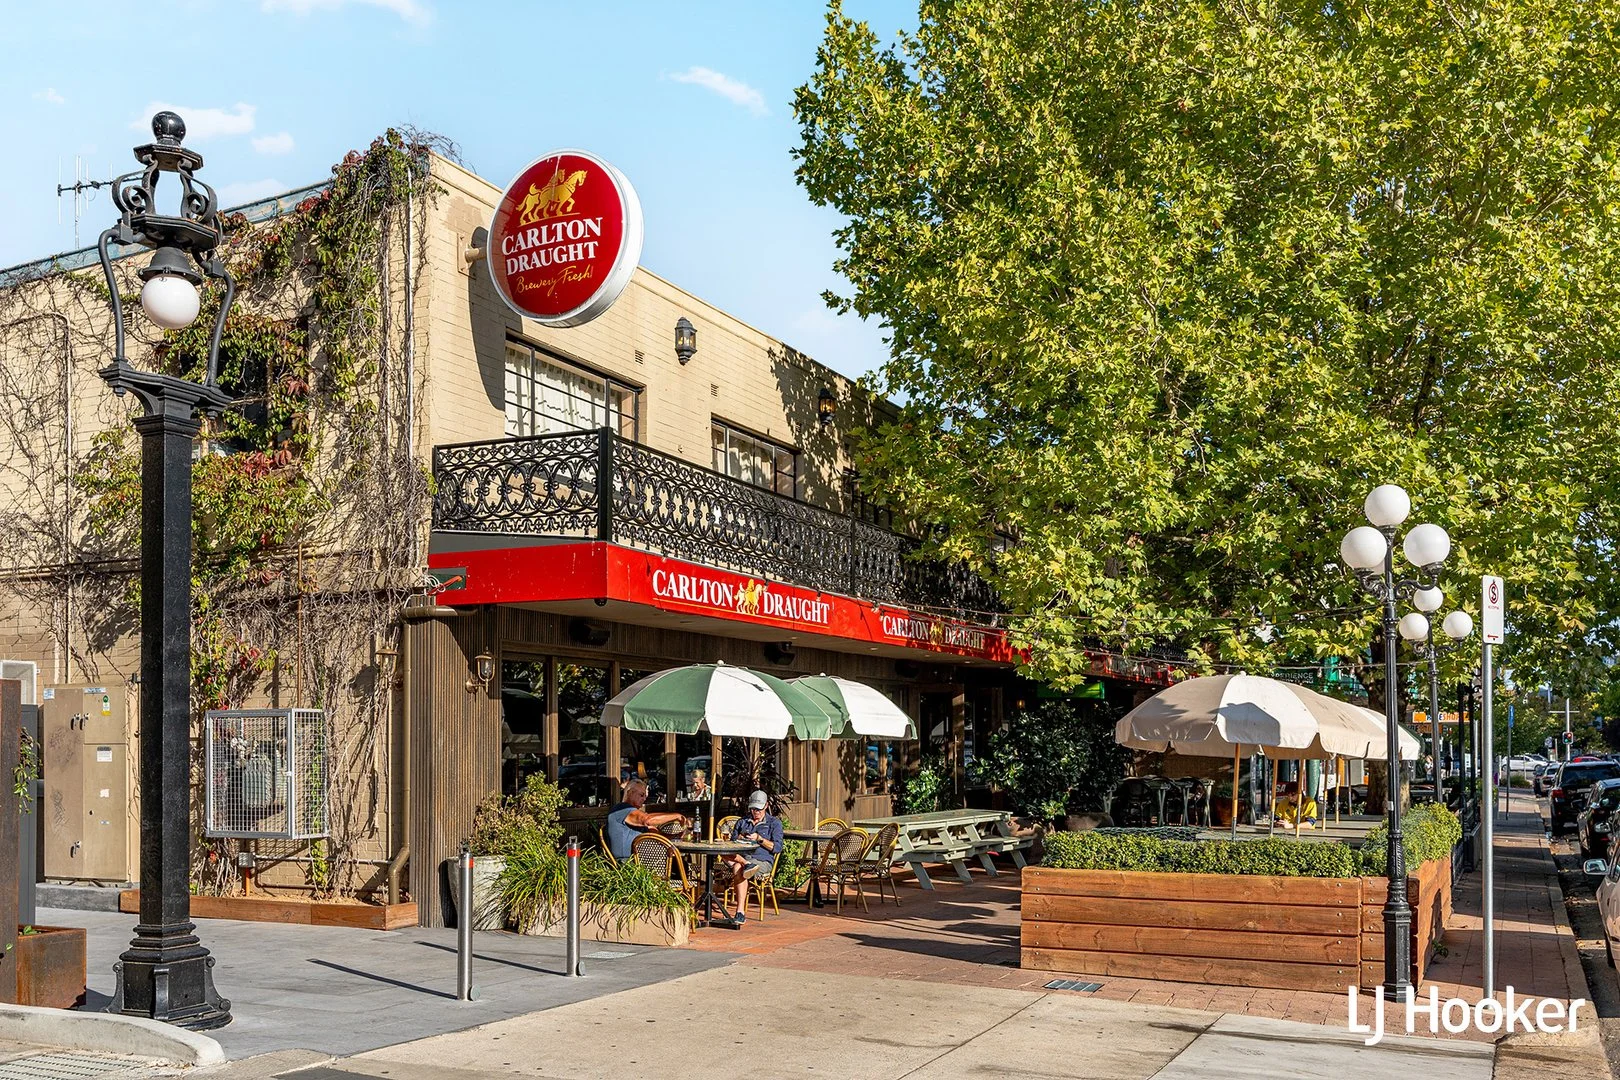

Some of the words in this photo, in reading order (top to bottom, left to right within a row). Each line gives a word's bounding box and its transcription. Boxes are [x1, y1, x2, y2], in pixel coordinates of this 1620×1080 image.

[501, 217, 603, 256] CARLTON
[506, 240, 599, 276] DRAUGHT
[515, 275, 562, 297] Brewery
[652, 569, 734, 608] CARLTON
[763, 591, 830, 625] DRAUGHT
[882, 614, 929, 641] CARLTON
[944, 626, 985, 650] DRAUGHT
